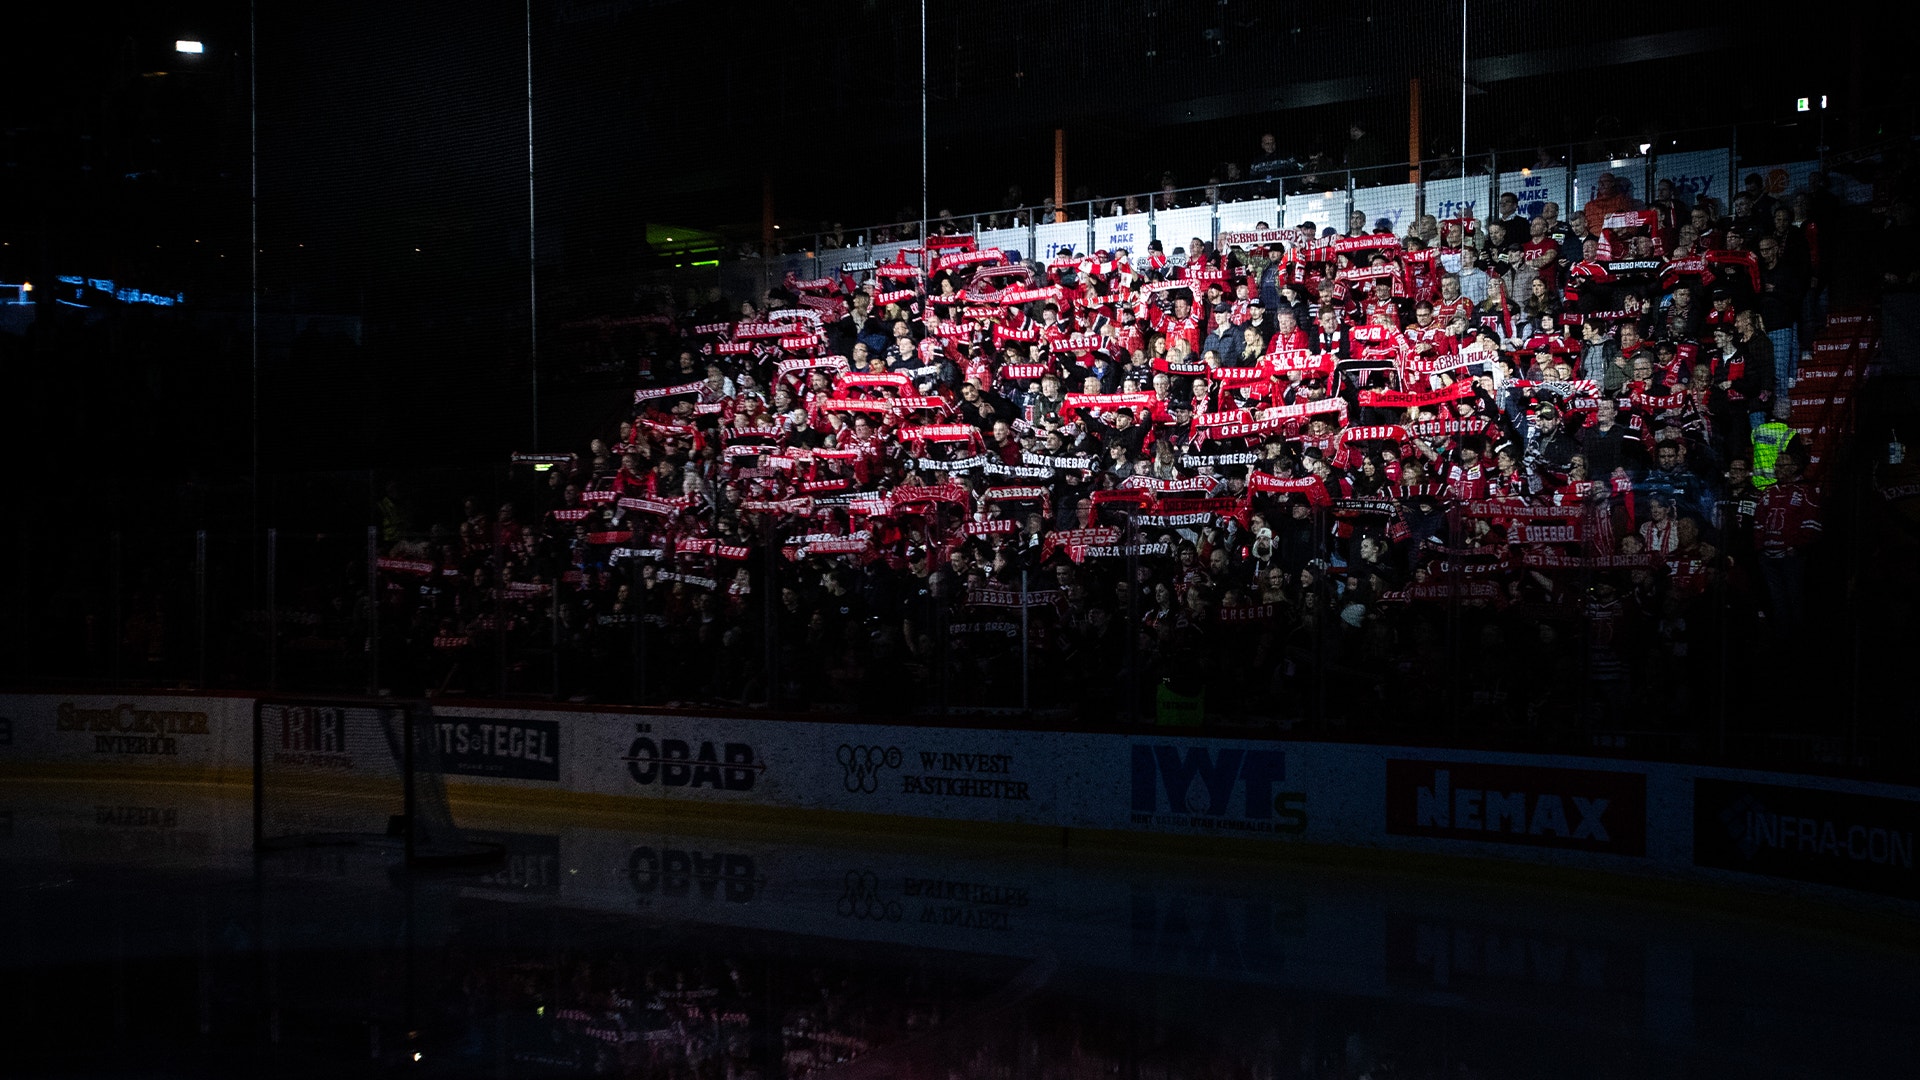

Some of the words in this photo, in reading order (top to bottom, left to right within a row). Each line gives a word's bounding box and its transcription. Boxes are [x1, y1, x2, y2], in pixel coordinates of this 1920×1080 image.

[1525, 177, 1542, 187] WE
[1518, 188, 1548, 200] MAKE
[1115, 222, 1129, 232] WE
[1182, 455, 1215, 468] FORZA
[480, 723, 554, 764] TEGEL
[627, 723, 755, 791] ÖBAB
[903, 775, 1030, 800] FASTIGHETER
